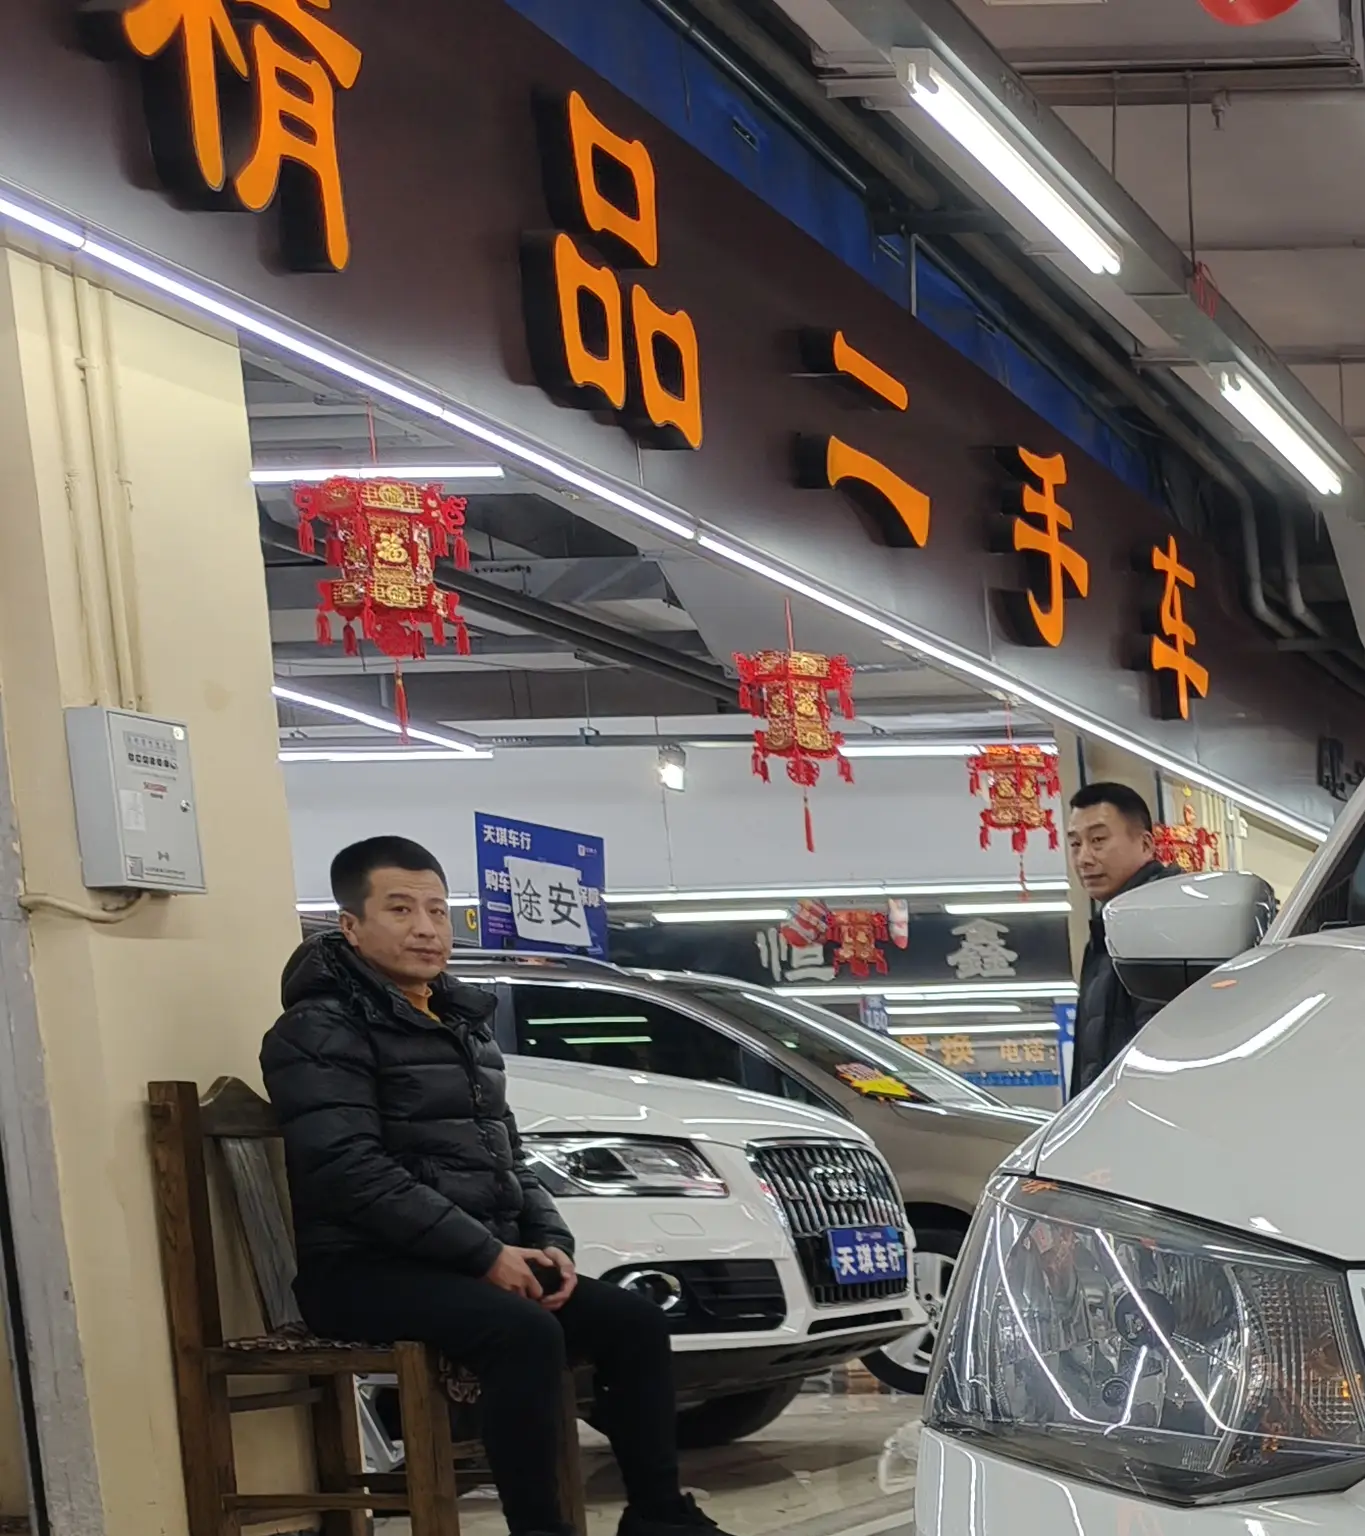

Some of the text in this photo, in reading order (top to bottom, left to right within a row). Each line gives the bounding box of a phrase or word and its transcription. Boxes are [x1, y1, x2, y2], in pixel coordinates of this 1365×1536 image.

[122, 0, 1209, 720] 精品二手车
[482, 824, 532, 851] 天琪车行
[513, 875, 582, 929] 途安
[836, 1241, 905, 1276] 天琪车行
